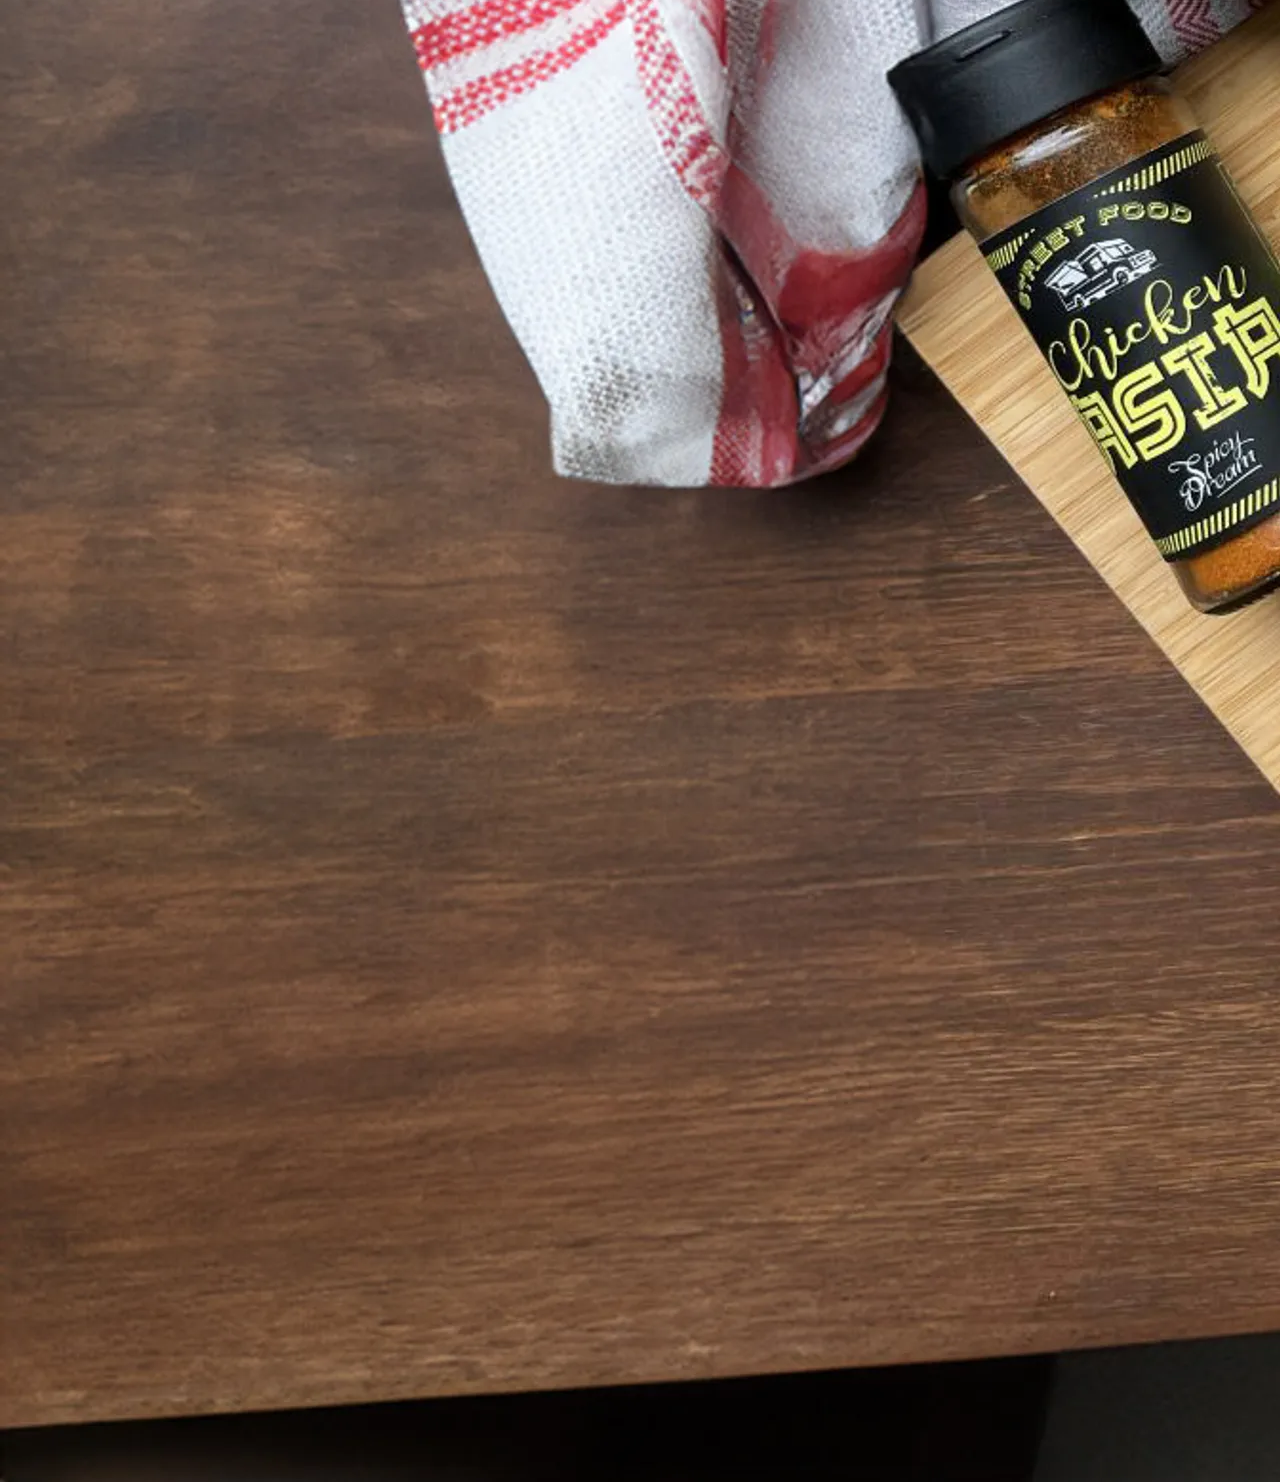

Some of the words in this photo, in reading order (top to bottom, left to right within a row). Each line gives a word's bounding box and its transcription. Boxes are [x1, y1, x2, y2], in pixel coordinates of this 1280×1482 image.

[1017, 215, 1086, 311] STREET
[1098, 201, 1192, 226] FOOD
[1049, 264, 1247, 392] Chicken
[1168, 430, 1255, 486] Spicy
[1179, 449, 1257, 511] Dream
